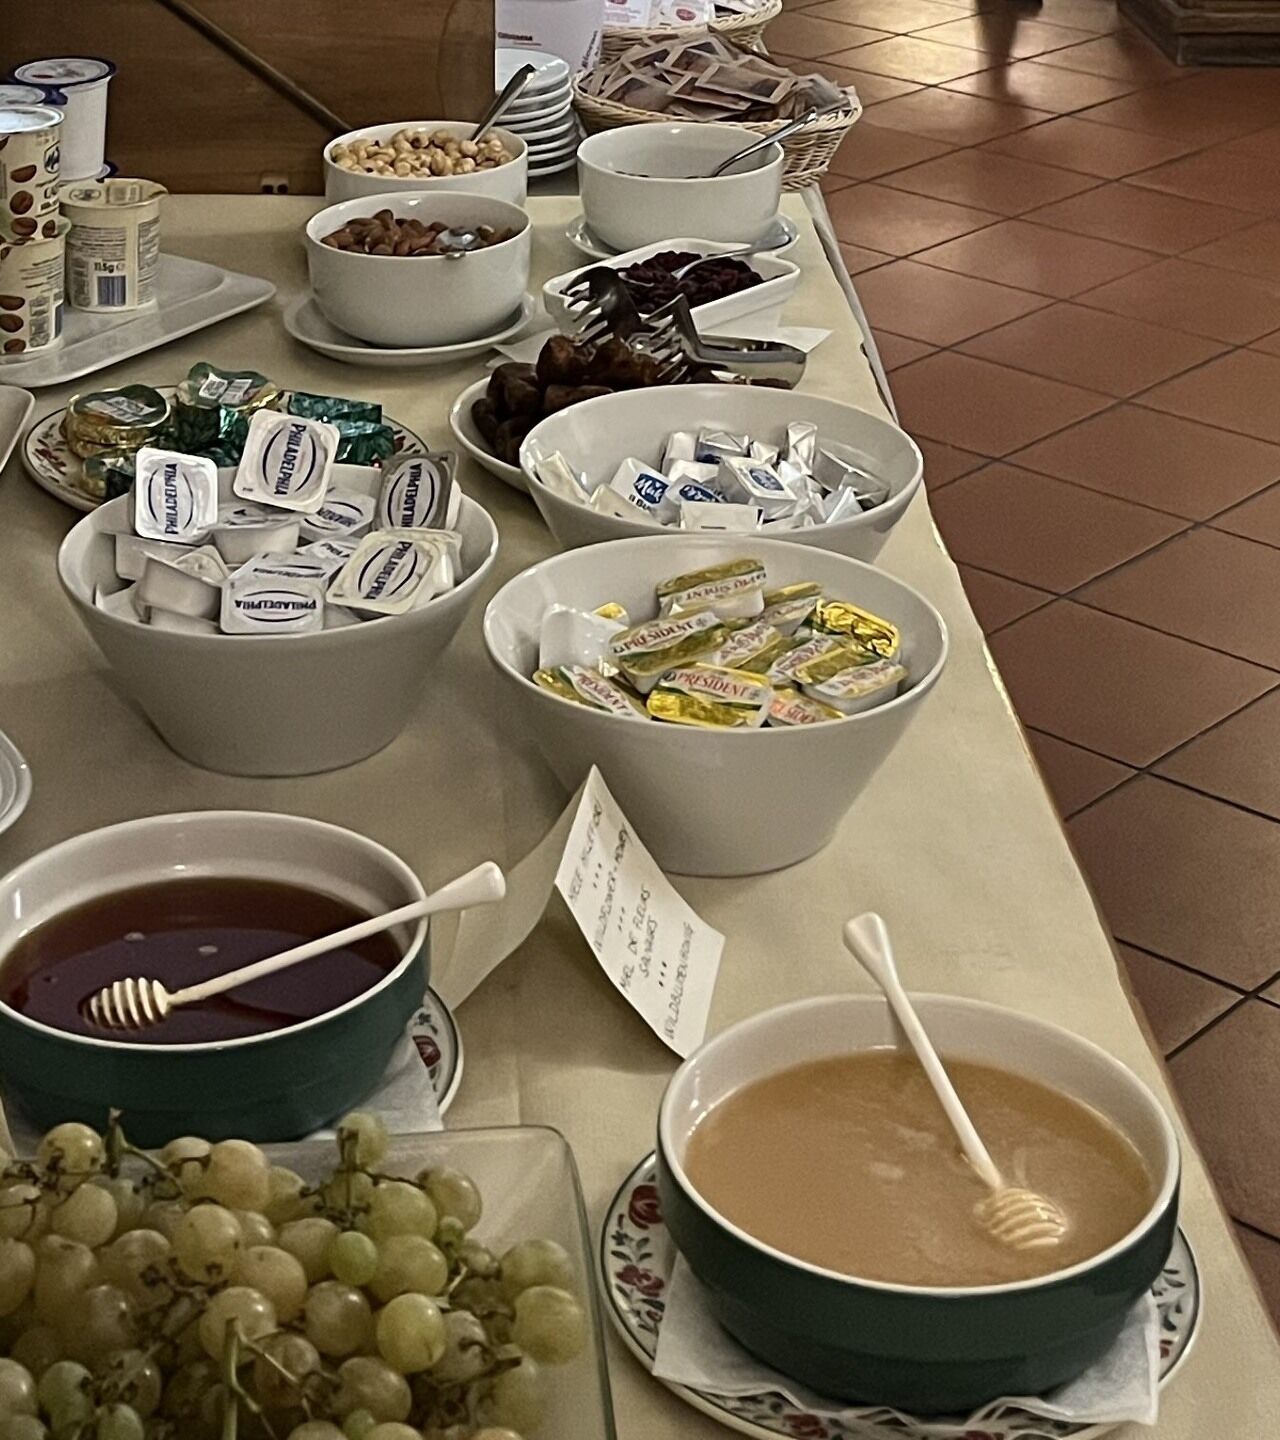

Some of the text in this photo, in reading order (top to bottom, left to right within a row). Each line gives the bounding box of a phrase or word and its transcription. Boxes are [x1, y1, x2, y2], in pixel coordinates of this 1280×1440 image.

[274, 423, 308, 496] PHILADELPHIA
[164, 462, 180, 535] PHILADELPHIA
[362, 540, 414, 600] PHILADELPHIA
[234, 598, 318, 611] PHILADELPHIA
